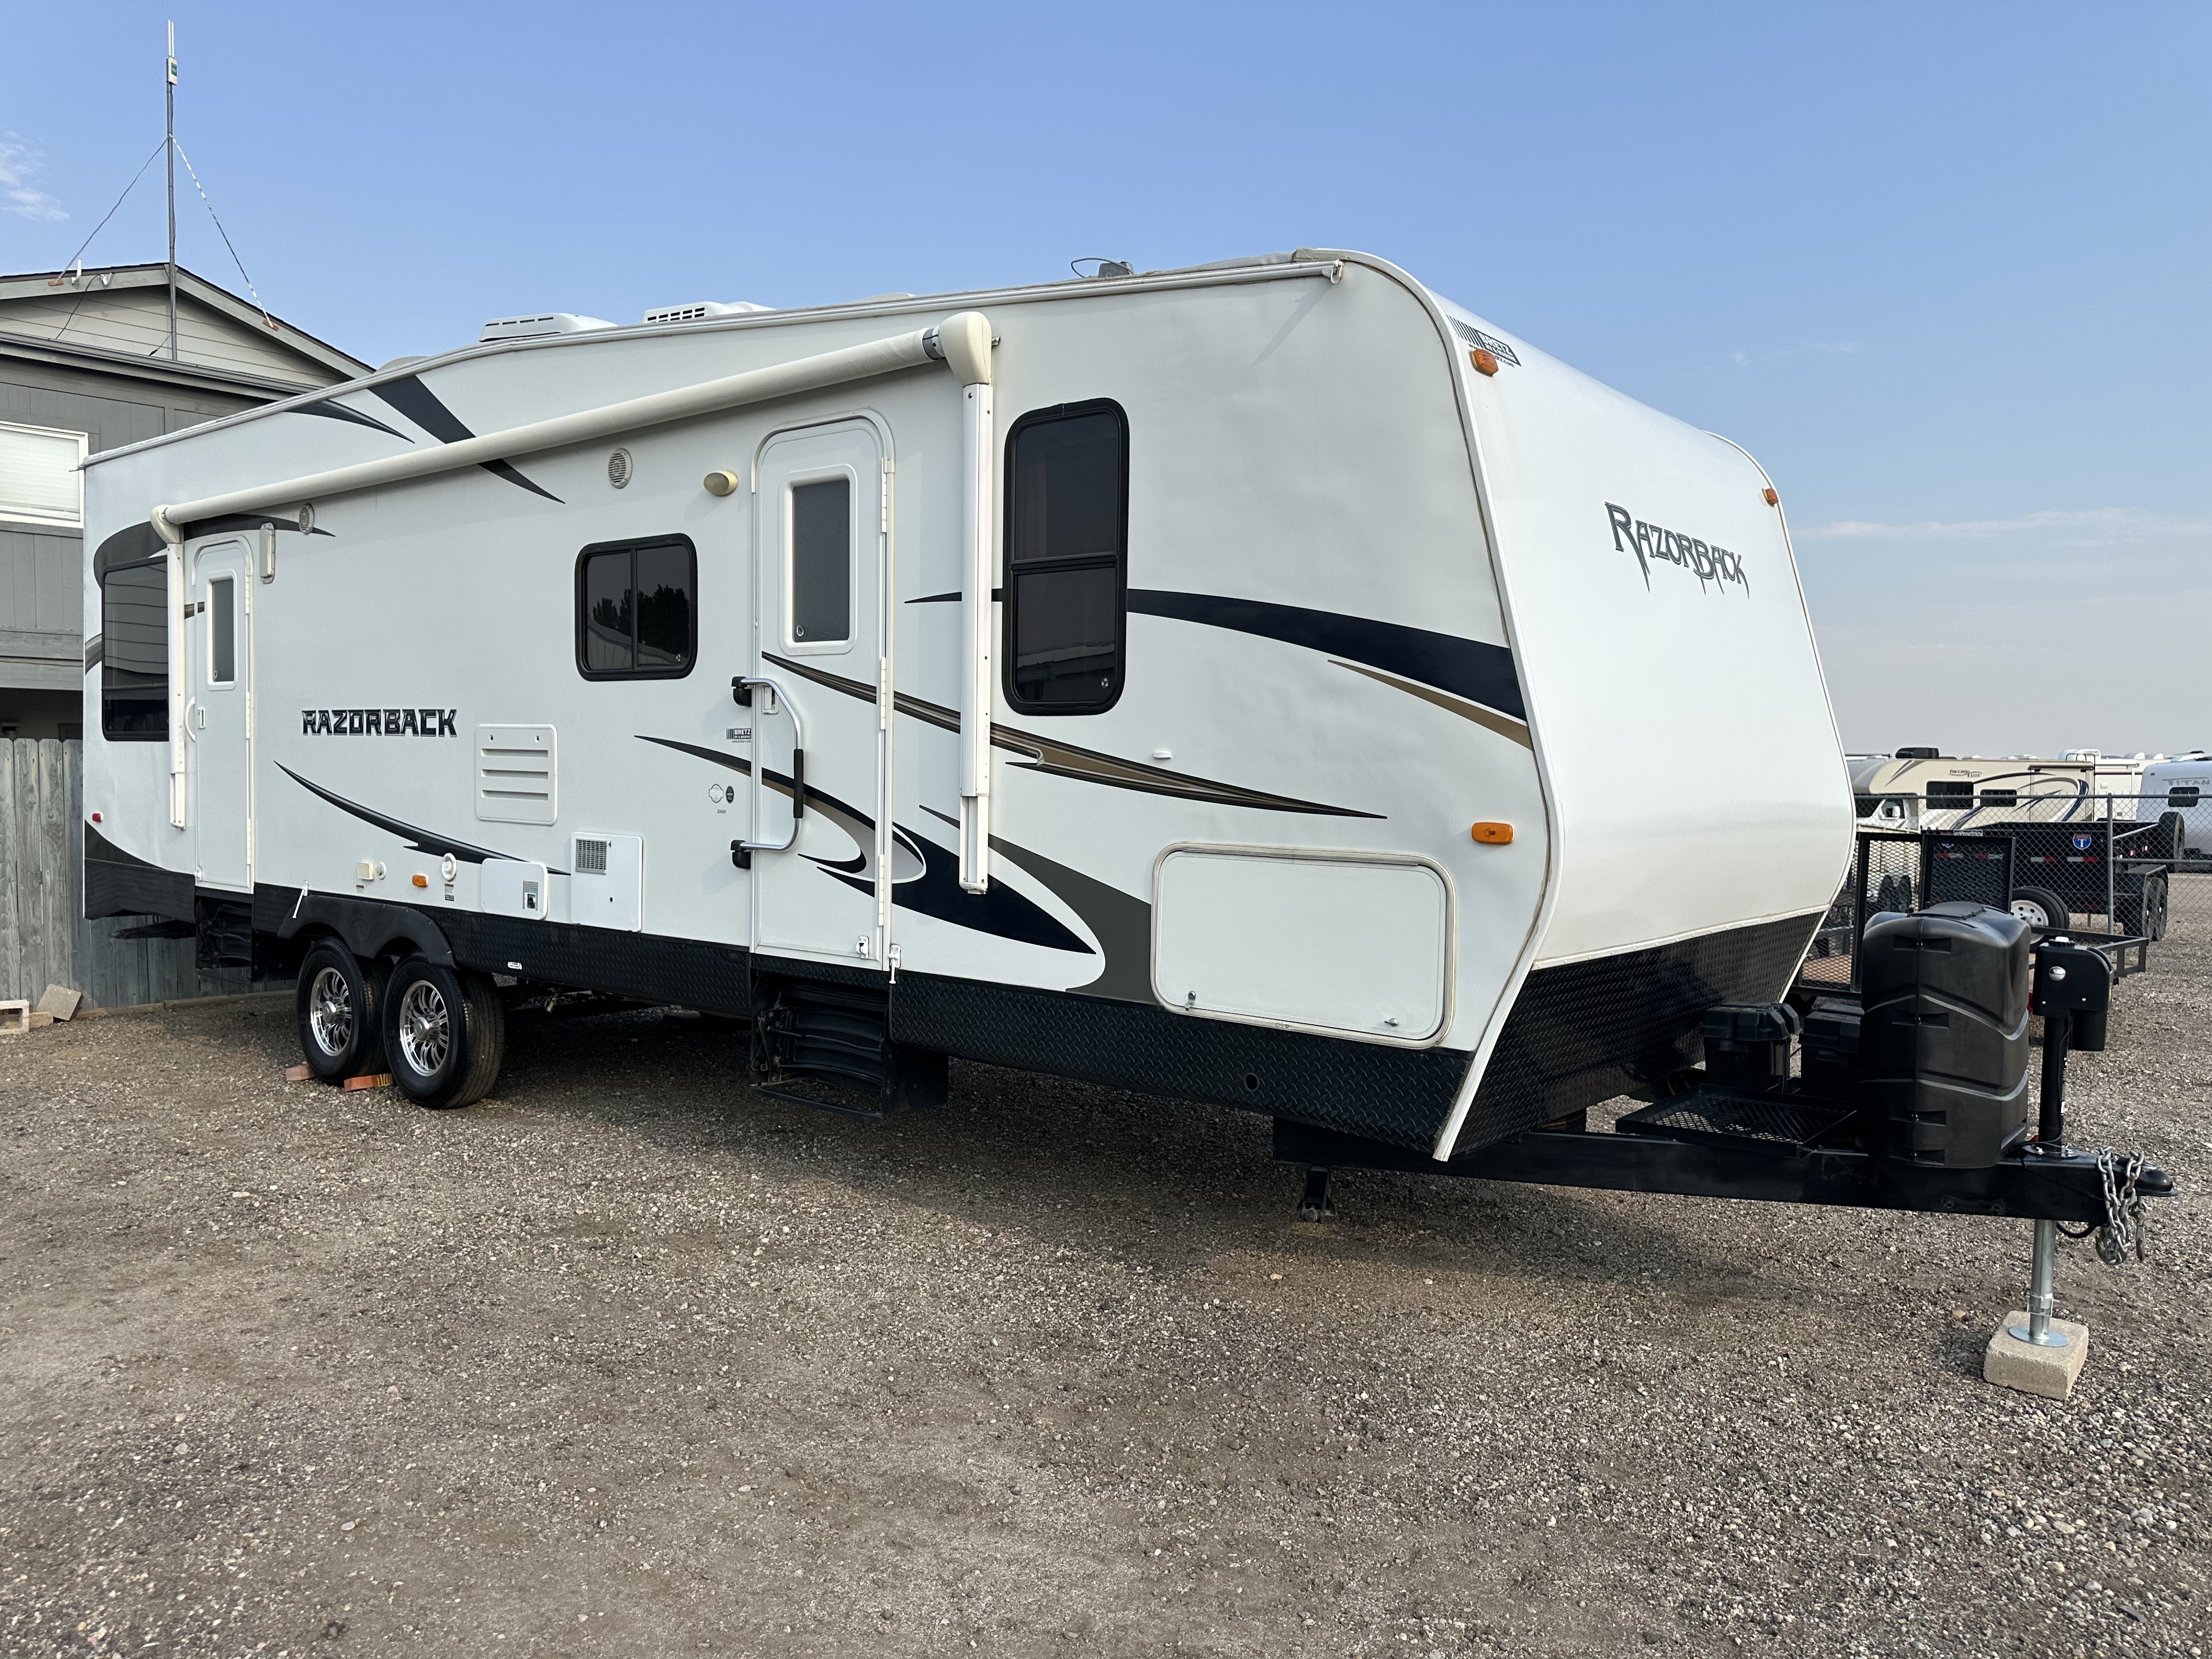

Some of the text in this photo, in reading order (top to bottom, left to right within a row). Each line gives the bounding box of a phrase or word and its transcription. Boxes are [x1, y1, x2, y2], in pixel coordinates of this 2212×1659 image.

[1476, 331, 1513, 356] BRETZ
[1605, 501, 1749, 600] RAZORBACK
[301, 709, 457, 737] RAZORBACK
[2162, 777, 2210, 786] TITAN
